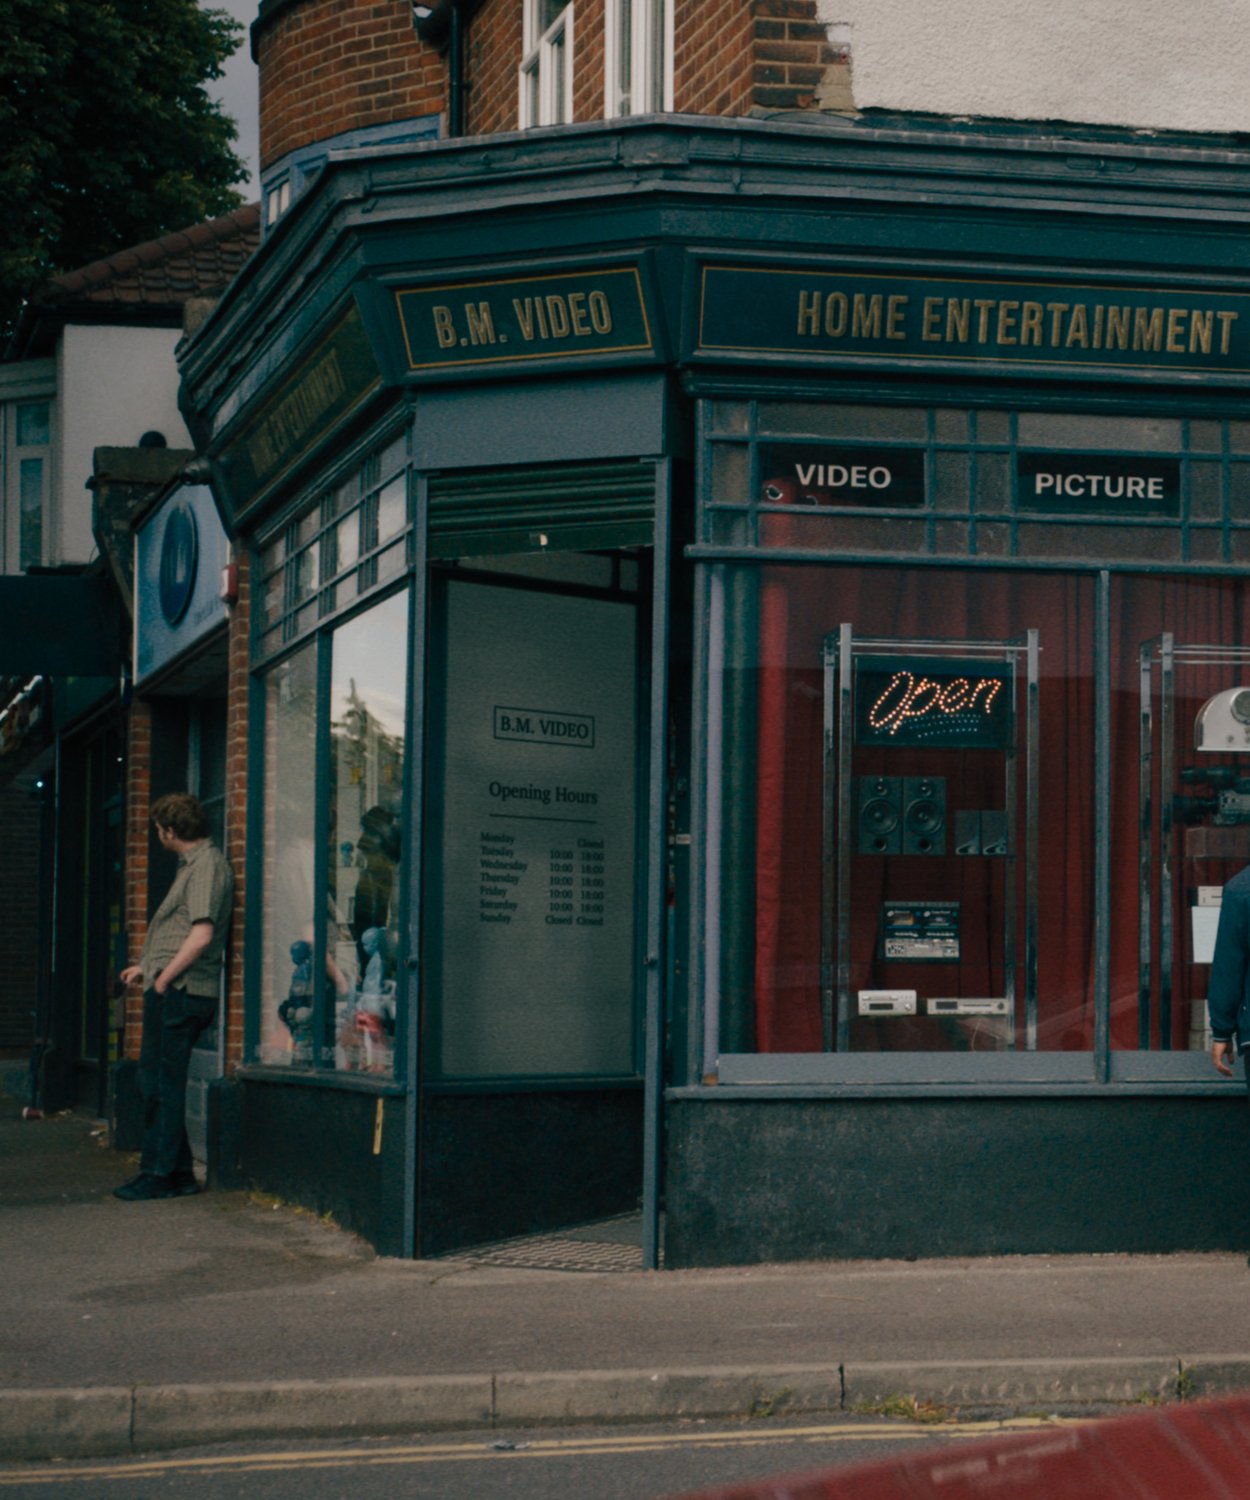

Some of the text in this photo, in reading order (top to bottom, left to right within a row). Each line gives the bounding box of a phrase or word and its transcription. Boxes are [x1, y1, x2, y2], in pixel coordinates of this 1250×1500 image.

[432, 290, 612, 348] B.M. VIDEO
[797, 290, 908, 340] HOME
[922, 296, 1239, 355] ENTERTAINMENT
[795, 463, 892, 490] VIDEO
[1034, 472, 1165, 500] PICTURE
[868, 670, 1003, 735] Open
[501, 716, 589, 739] B.M. VIDEO
[489, 781, 599, 805] Opening Hours
[480, 832, 515, 845] Monday
[480, 846, 514, 858] Tuesday
[480, 859, 528, 872] Wednesday
[480, 872, 519, 885] Thursday
[480, 885, 507, 898] Friday
[480, 913, 512, 925] Sunday
